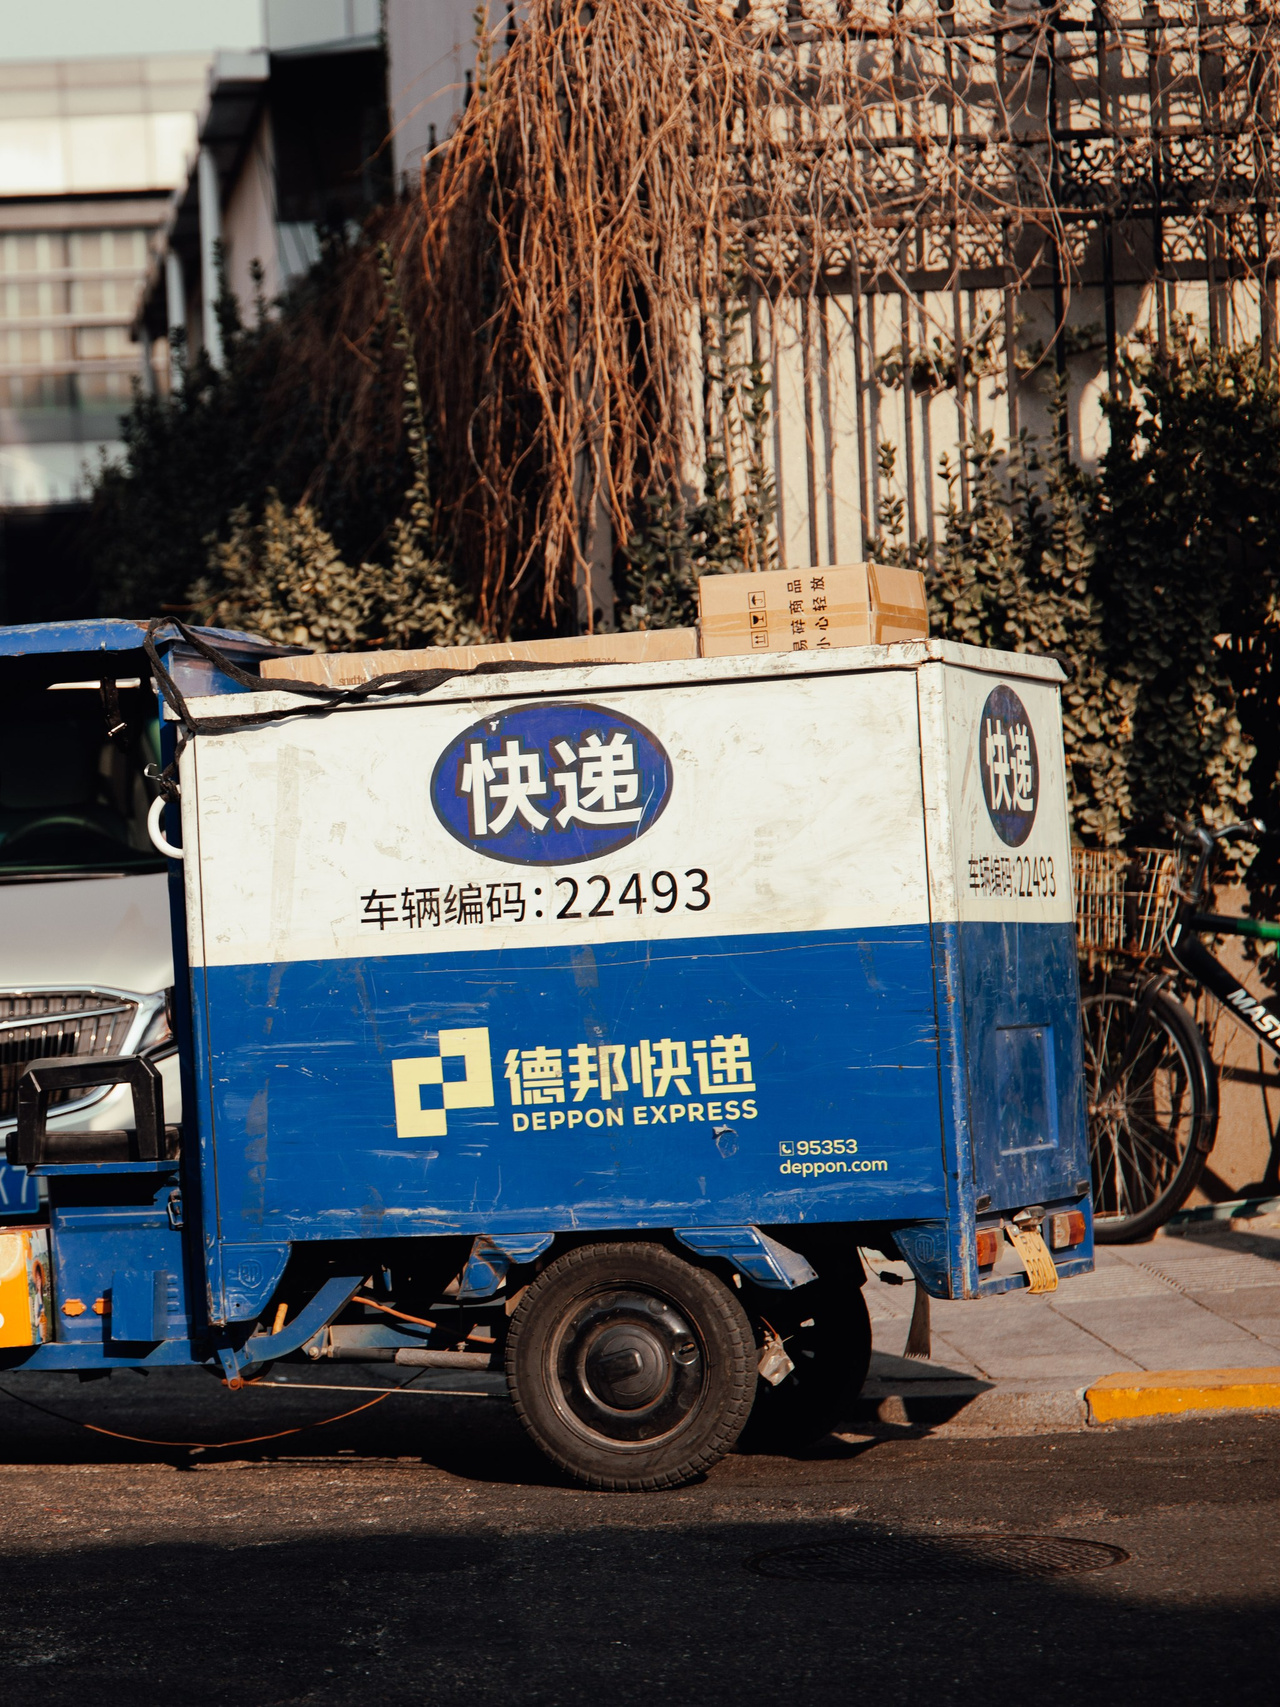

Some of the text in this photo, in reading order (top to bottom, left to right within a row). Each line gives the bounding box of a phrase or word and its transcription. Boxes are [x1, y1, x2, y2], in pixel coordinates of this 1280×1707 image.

[787, 578, 809, 651] 易碎商品
[810, 576, 831, 650] 小心轻放
[460, 732, 644, 836] 快递
[985, 718, 1034, 812] 快递
[360, 868, 712, 931] 车辆编码:22493
[1226, 988, 1280, 1048] MAST
[503, 1034, 757, 1106] 德邦快递
[512, 1099, 758, 1132] DEPPON EXPRESS
[796, 1138, 858, 1156] 95353
[779, 1159, 888, 1178] deppon.com
